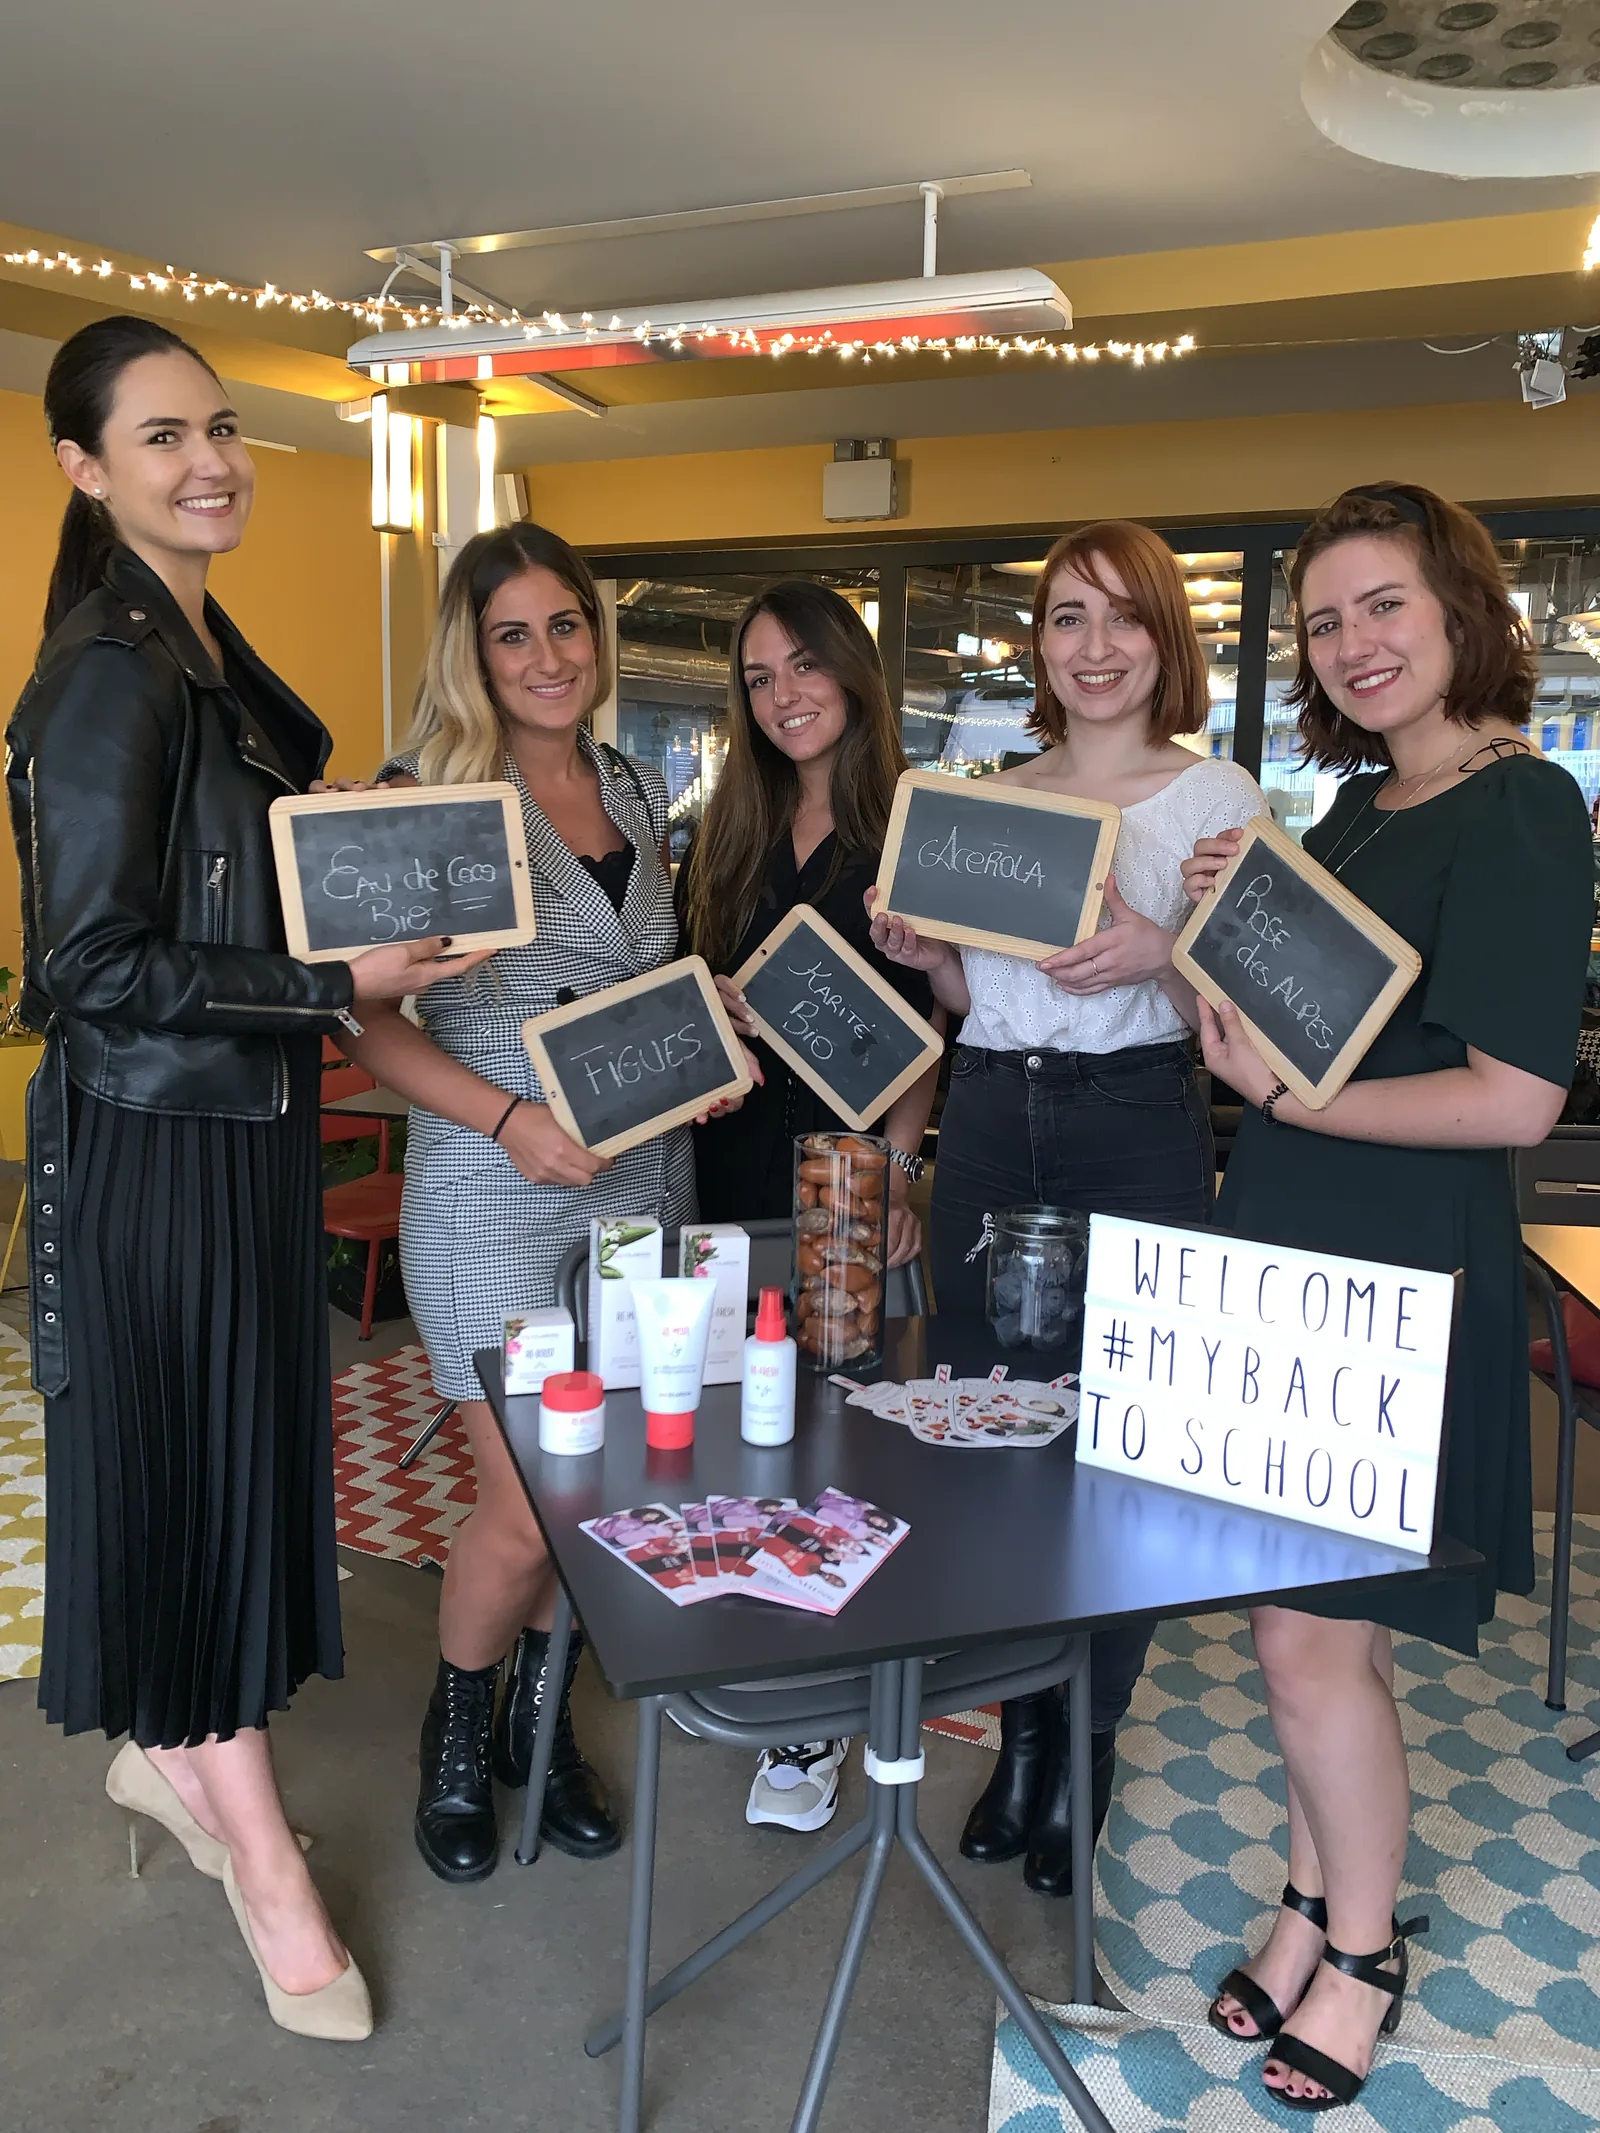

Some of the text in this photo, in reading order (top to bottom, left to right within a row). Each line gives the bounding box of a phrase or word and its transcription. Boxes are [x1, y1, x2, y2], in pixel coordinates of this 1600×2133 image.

[403, 858, 439, 892] de
[1236, 944, 1333, 1050] des ALPES
[1135, 1238, 1418, 1351] WELCOME
[1102, 1318, 1400, 1438] #MYBACK
[1086, 1391, 1418, 1532] TO SCHOOL
